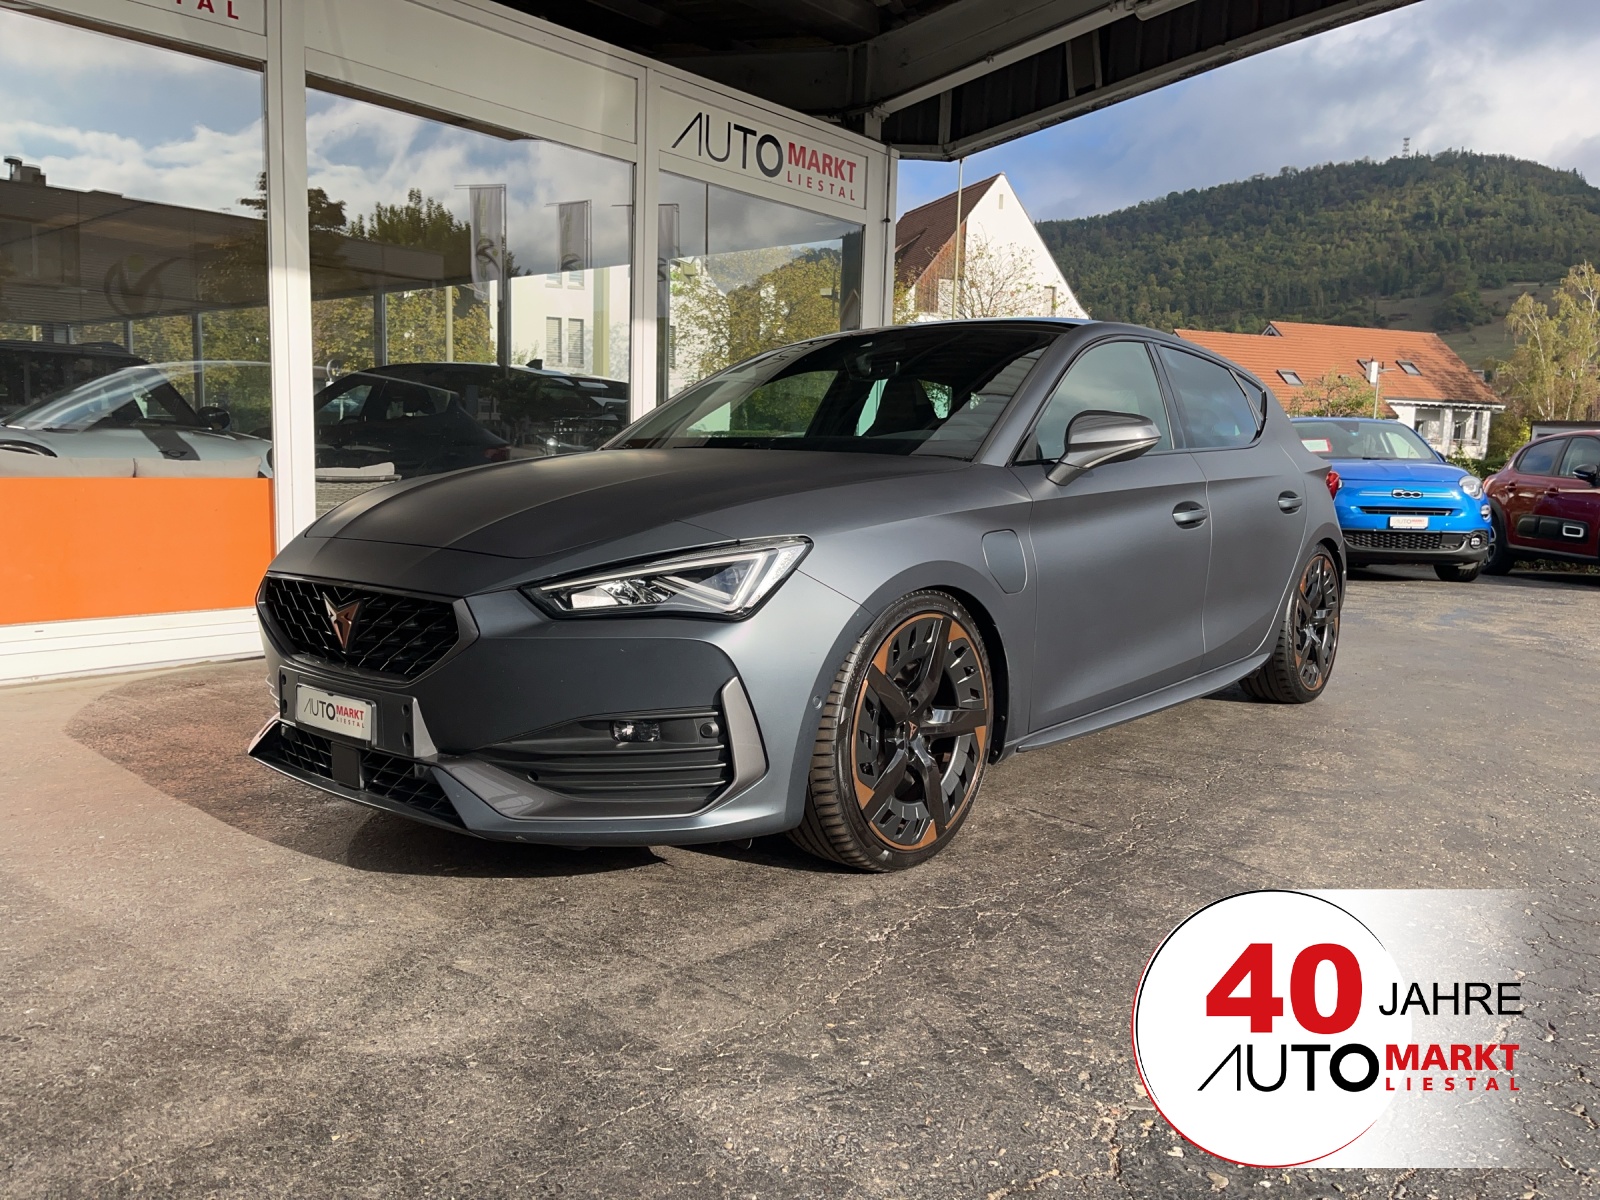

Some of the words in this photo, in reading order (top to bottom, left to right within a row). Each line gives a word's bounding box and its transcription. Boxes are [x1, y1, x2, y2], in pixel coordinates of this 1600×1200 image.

[176, 0, 239, 20] AL
[671, 112, 784, 178] AUTO
[788, 141, 857, 184] MARKT
[787, 170, 856, 201] LIESTAL
[304, 698, 335, 720] AUTO
[336, 705, 364, 720] MARKT
[336, 717, 365, 729] LIESTAL
